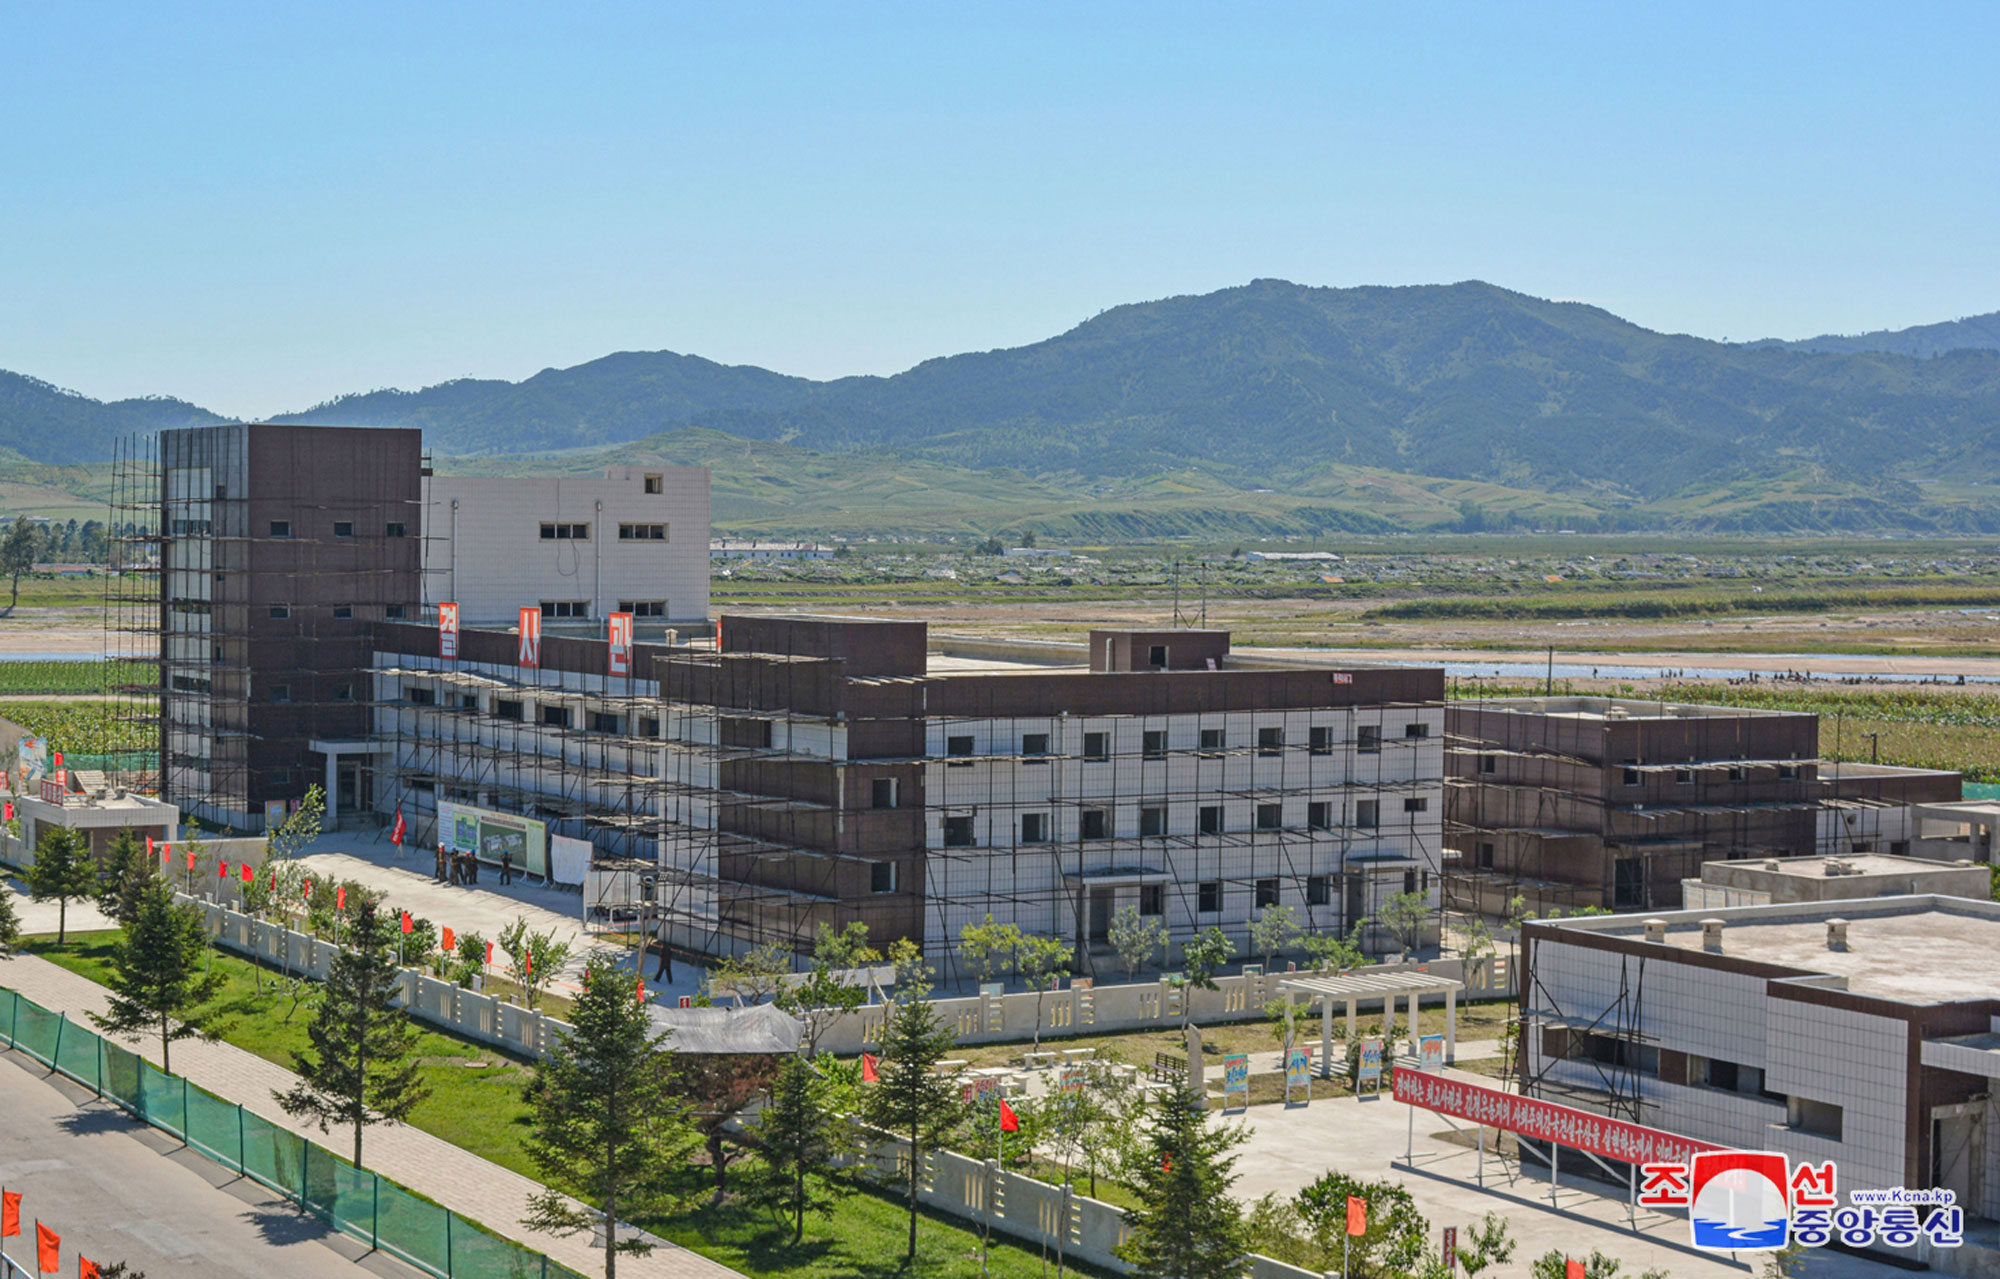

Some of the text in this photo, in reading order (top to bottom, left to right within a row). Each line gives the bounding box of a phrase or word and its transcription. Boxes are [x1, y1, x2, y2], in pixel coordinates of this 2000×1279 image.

[440, 607, 456, 656] 결
[521, 611, 540, 664] 사
[1464, 1088, 1510, 1126] 김정은동지의
